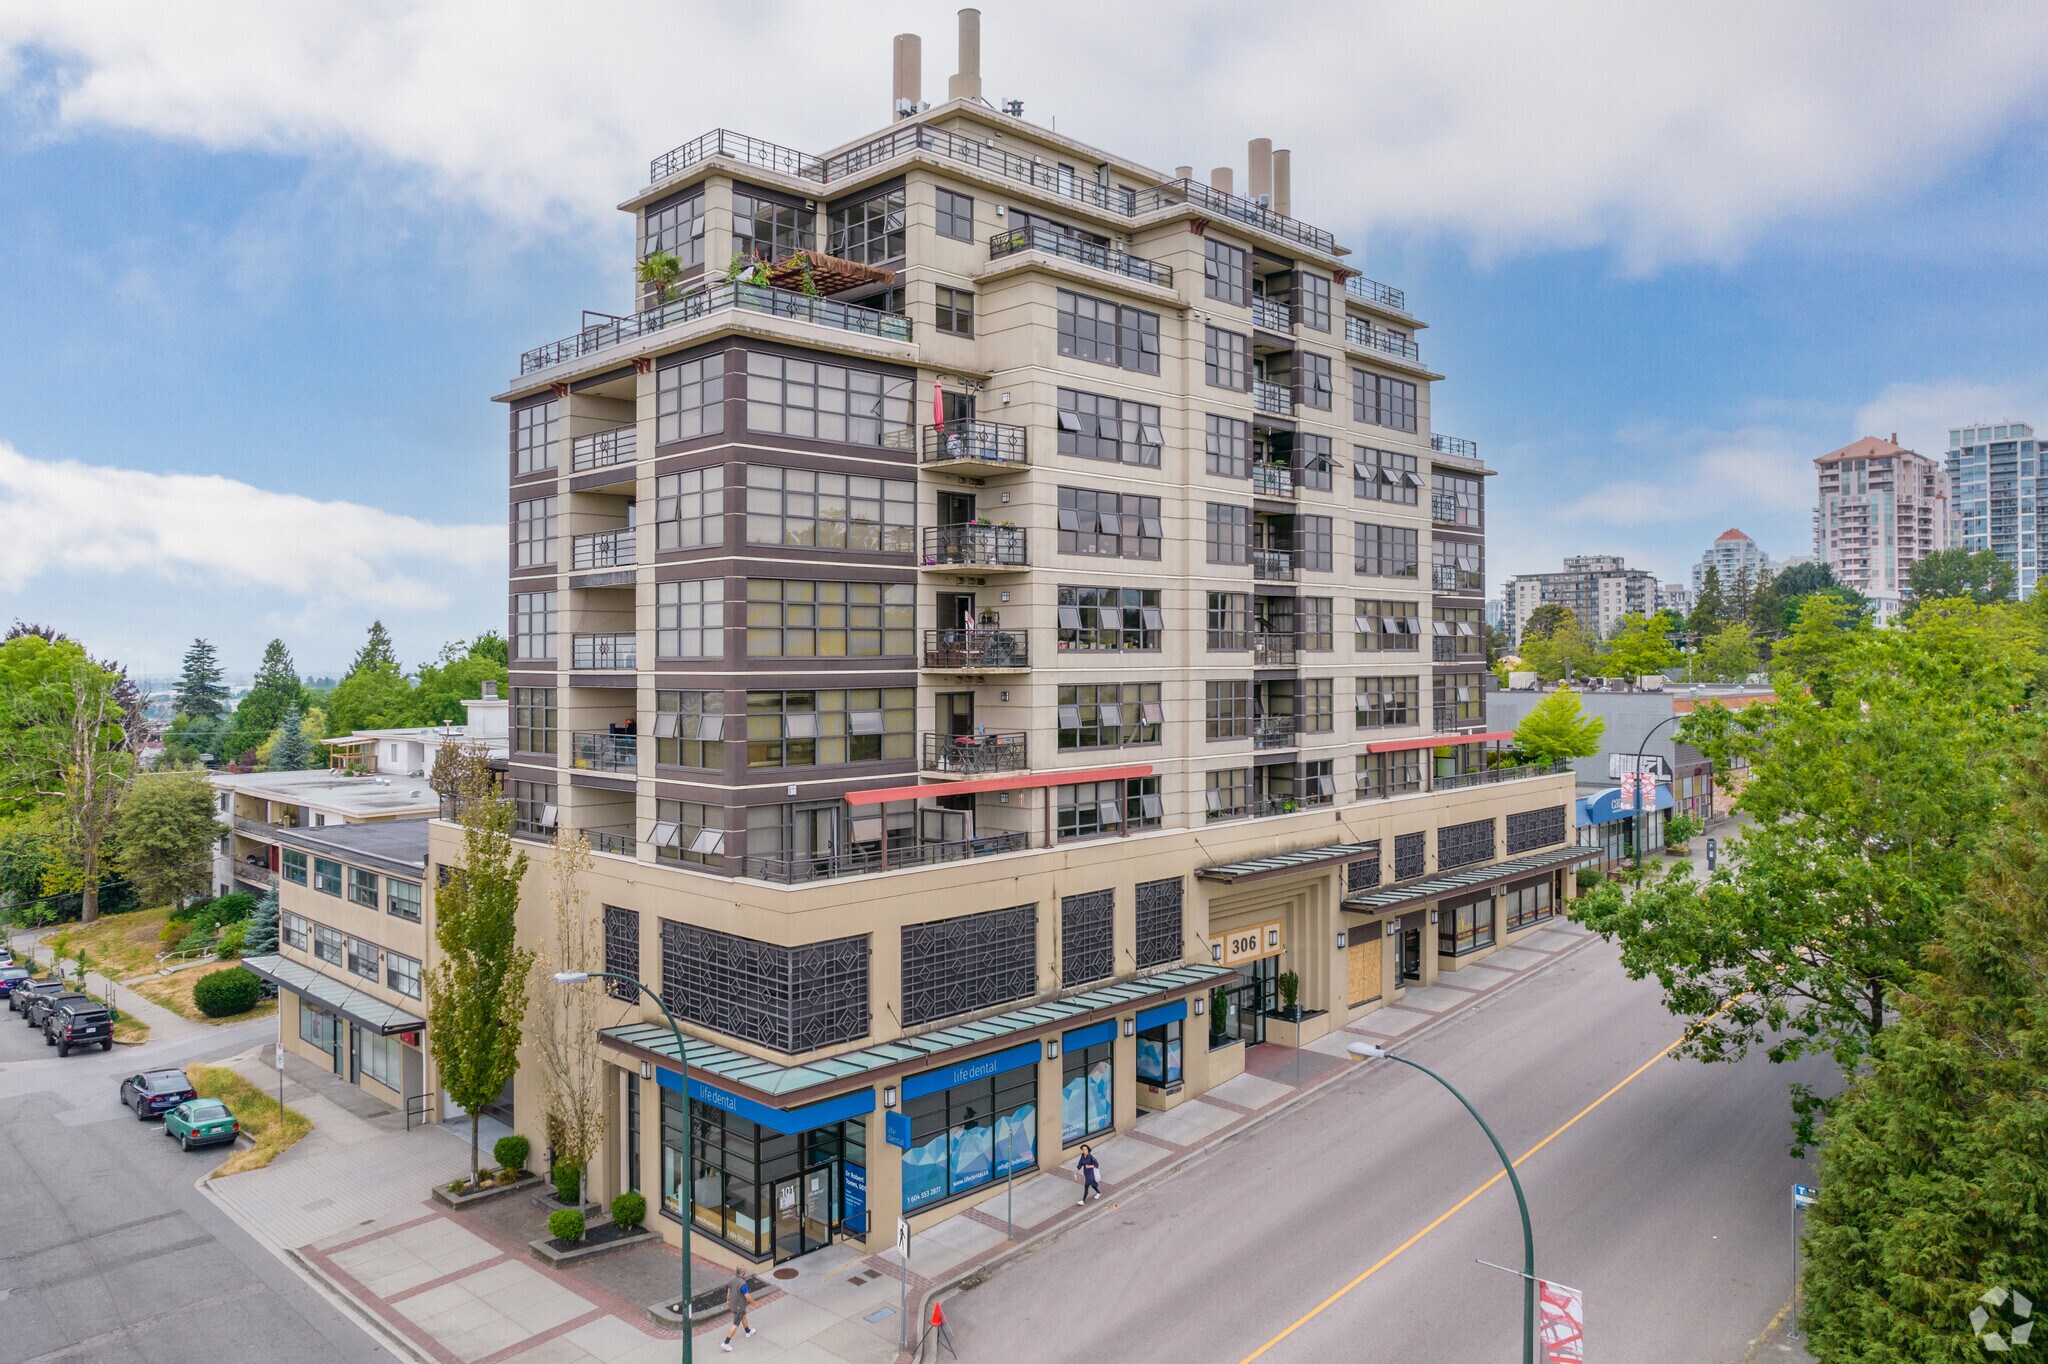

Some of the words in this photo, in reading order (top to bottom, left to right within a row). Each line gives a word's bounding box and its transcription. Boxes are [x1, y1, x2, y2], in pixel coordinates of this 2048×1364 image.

[1232, 935, 1257, 955] 306
[953, 1068, 969, 1083] life
[969, 1059, 997, 1079] dental
[700, 1084, 712, 1102] life
[712, 1090, 737, 1111] dental
[887, 1126, 897, 1136] life
[887, 1134, 905, 1147] dental
[781, 1185, 795, 1198] 101
[911, 1193, 920, 1202] 604
[921, 1190, 930, 1199] 553
